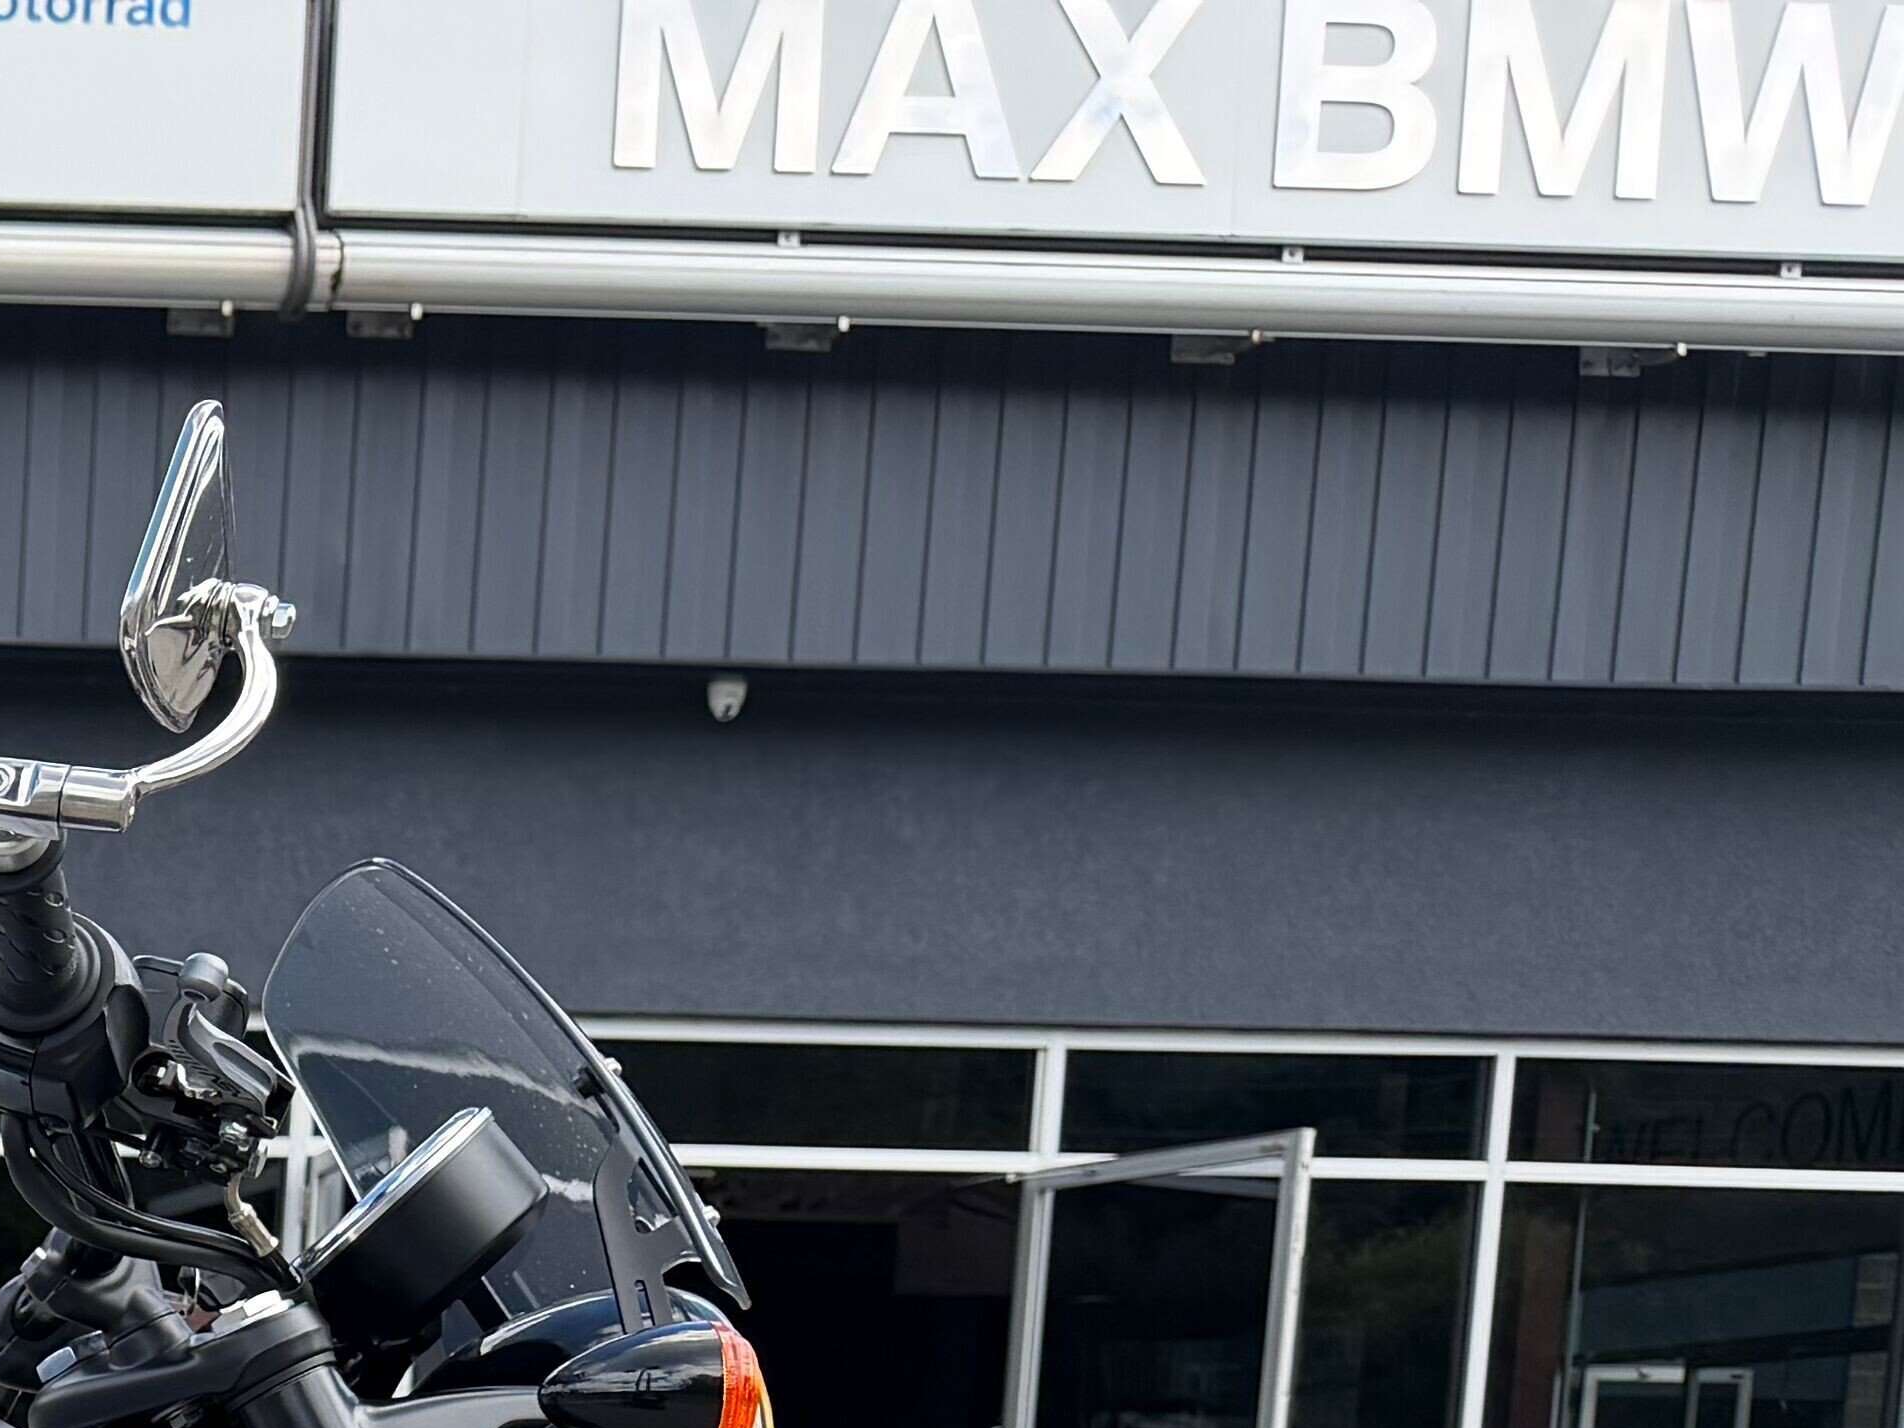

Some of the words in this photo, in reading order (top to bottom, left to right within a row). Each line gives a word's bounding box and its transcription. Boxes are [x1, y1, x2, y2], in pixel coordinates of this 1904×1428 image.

[612, 0, 1208, 188] MAX
[1273, 0, 1904, 206] BMW
[1585, 1078, 1904, 1165] WELCOM
